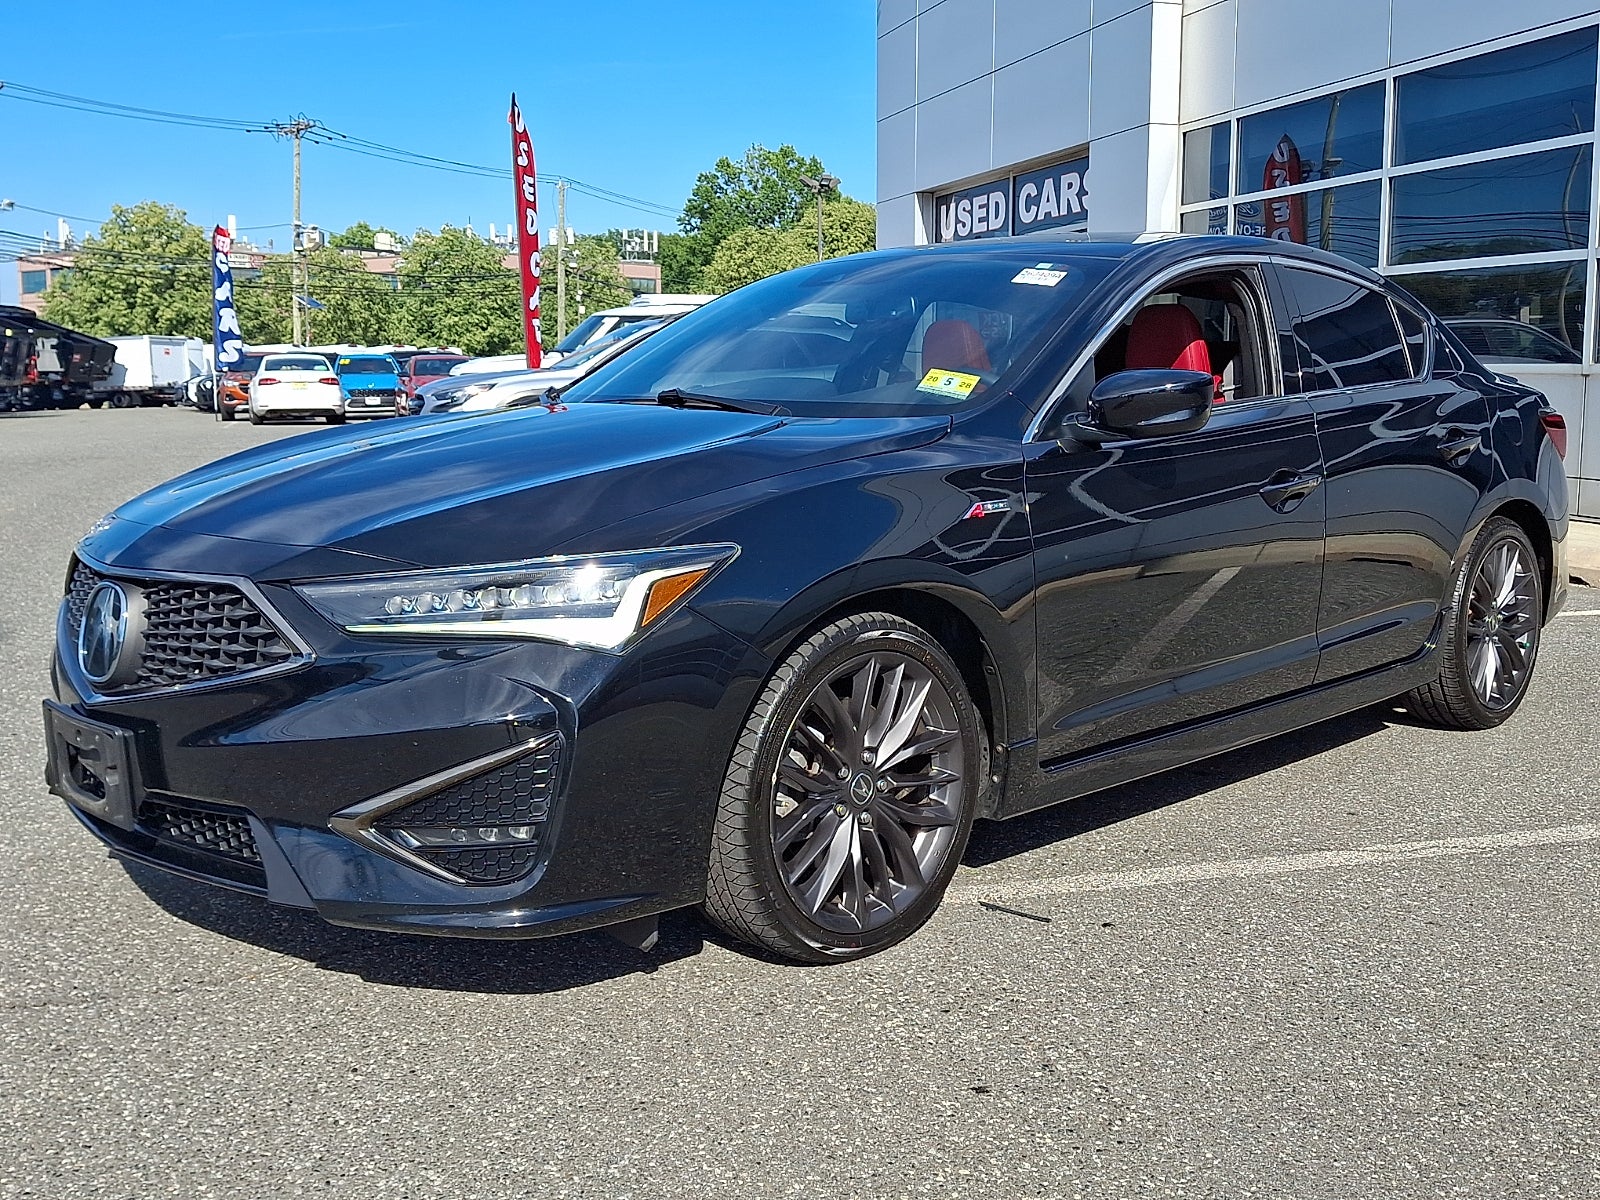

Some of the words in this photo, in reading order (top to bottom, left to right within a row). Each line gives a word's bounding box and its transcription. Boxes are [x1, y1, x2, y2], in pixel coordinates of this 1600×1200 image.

[514, 105, 539, 236] USED
[940, 191, 1006, 240] USED
[215, 252, 243, 364] CARS
[926, 375, 939, 383] 20
[943, 377, 955, 386] 5
[958, 381, 972, 389] 28
